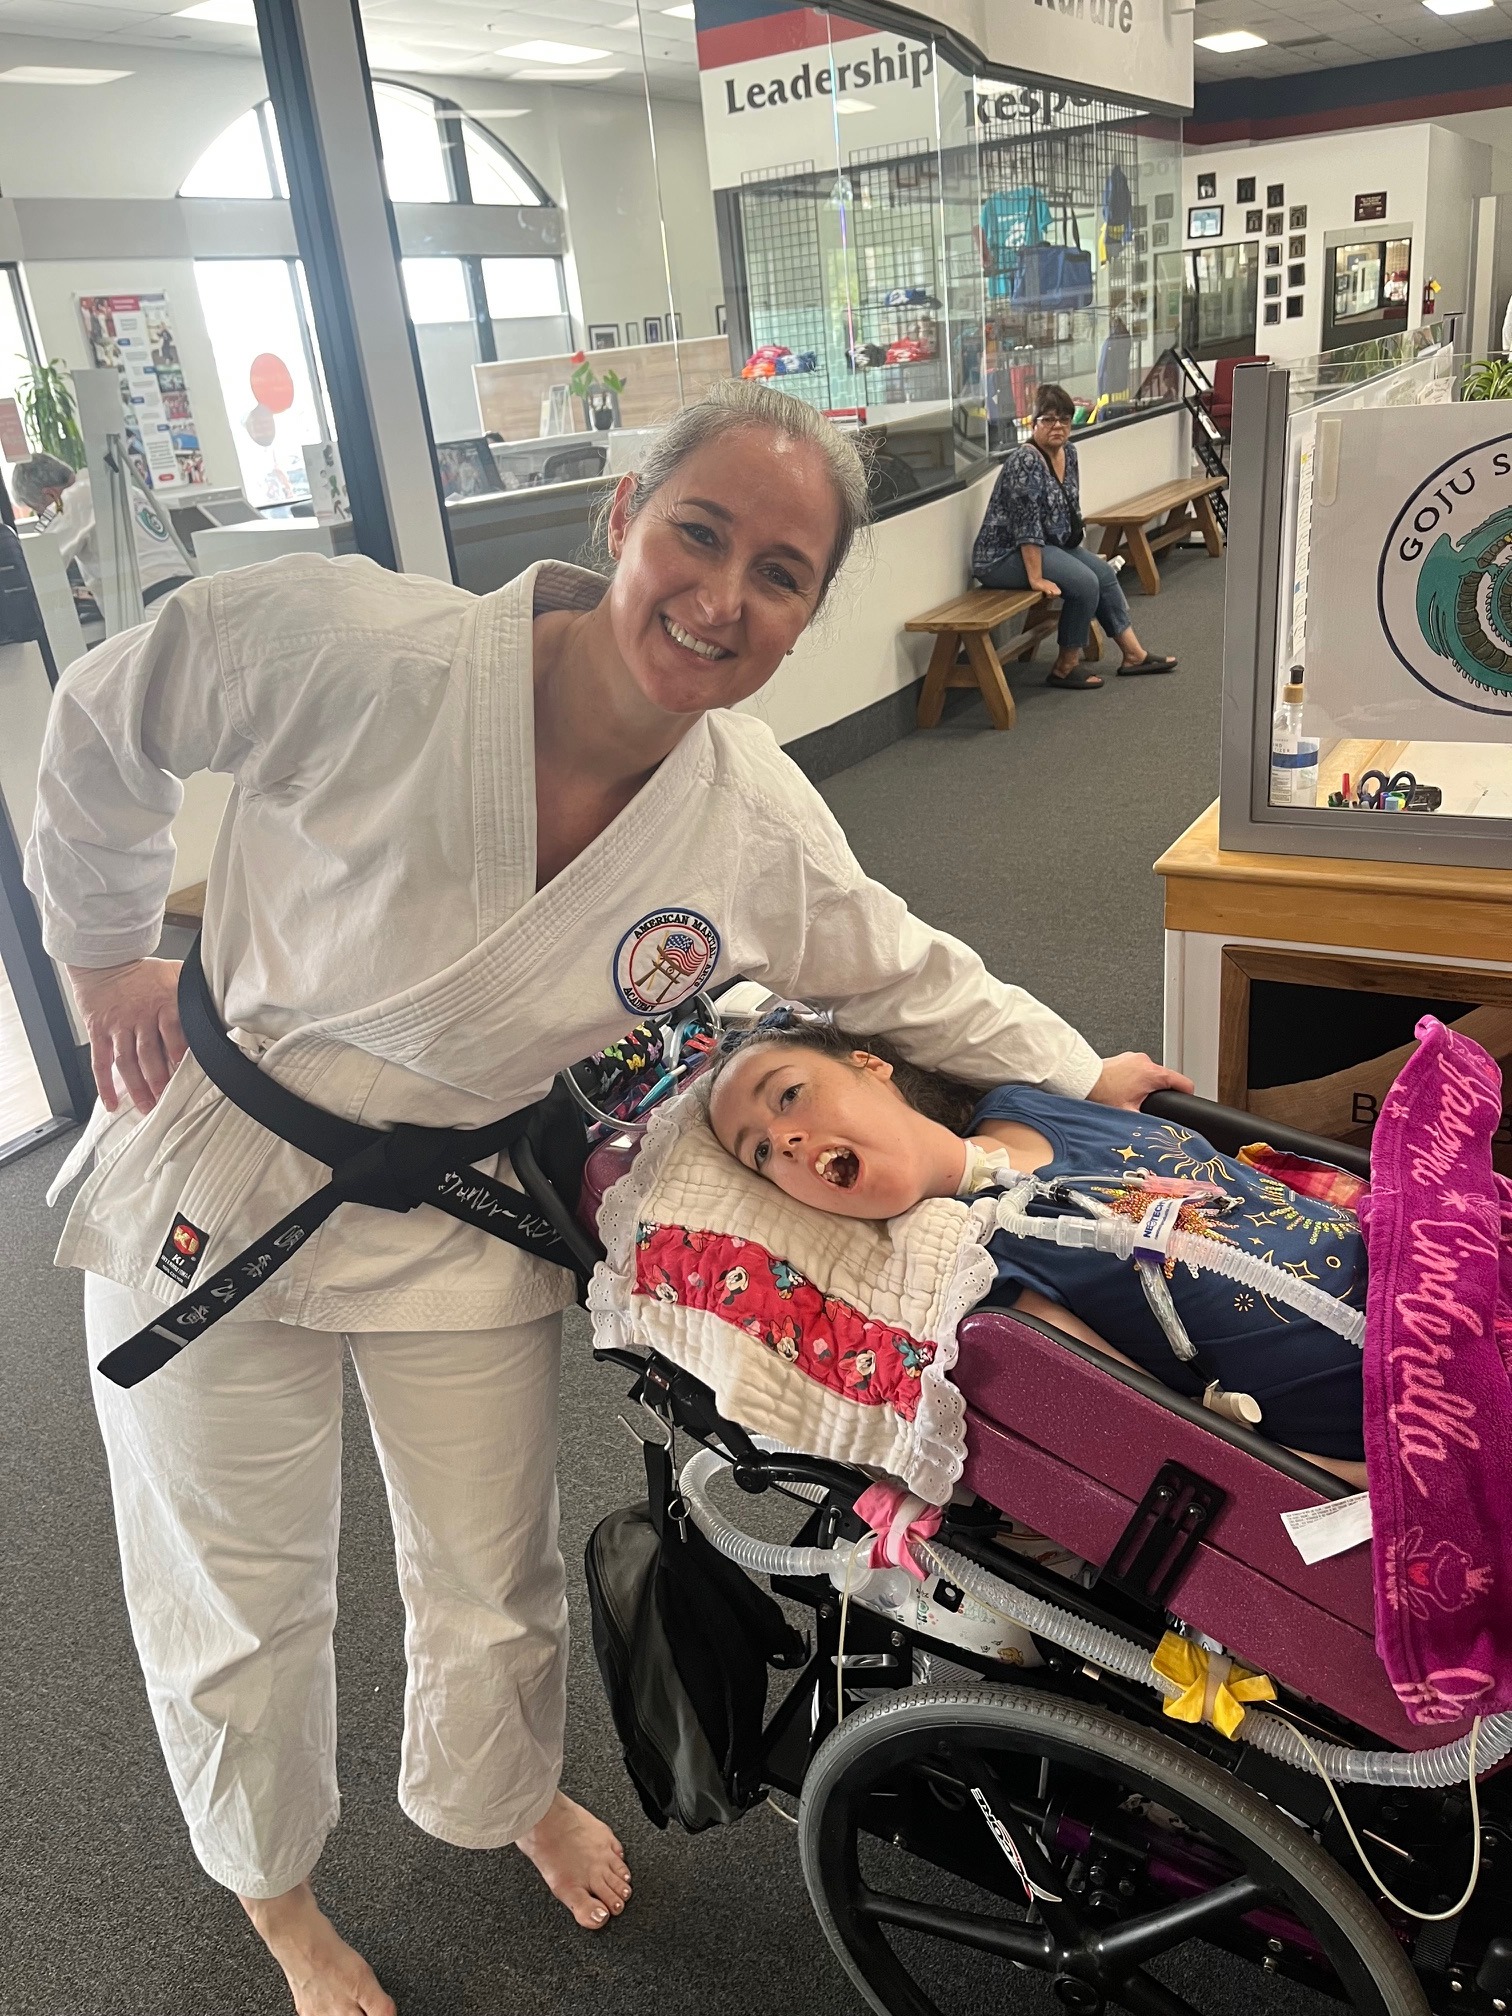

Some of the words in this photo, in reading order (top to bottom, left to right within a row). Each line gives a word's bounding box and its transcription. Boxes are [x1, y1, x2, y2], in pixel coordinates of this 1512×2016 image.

[1034, 0, 1134, 34] arate
[724, 41, 935, 115] Leadership
[1399, 466, 1476, 562] GOJU
[633, 914, 690, 939] AMERICAN
[692, 919, 717, 959] MARTIAL
[694, 963, 712, 988] ARTS
[623, 987, 655, 1012] ACADEMY
[171, 1253, 185, 1266] KI
[1389, 1219, 1499, 1498] Cinderella
